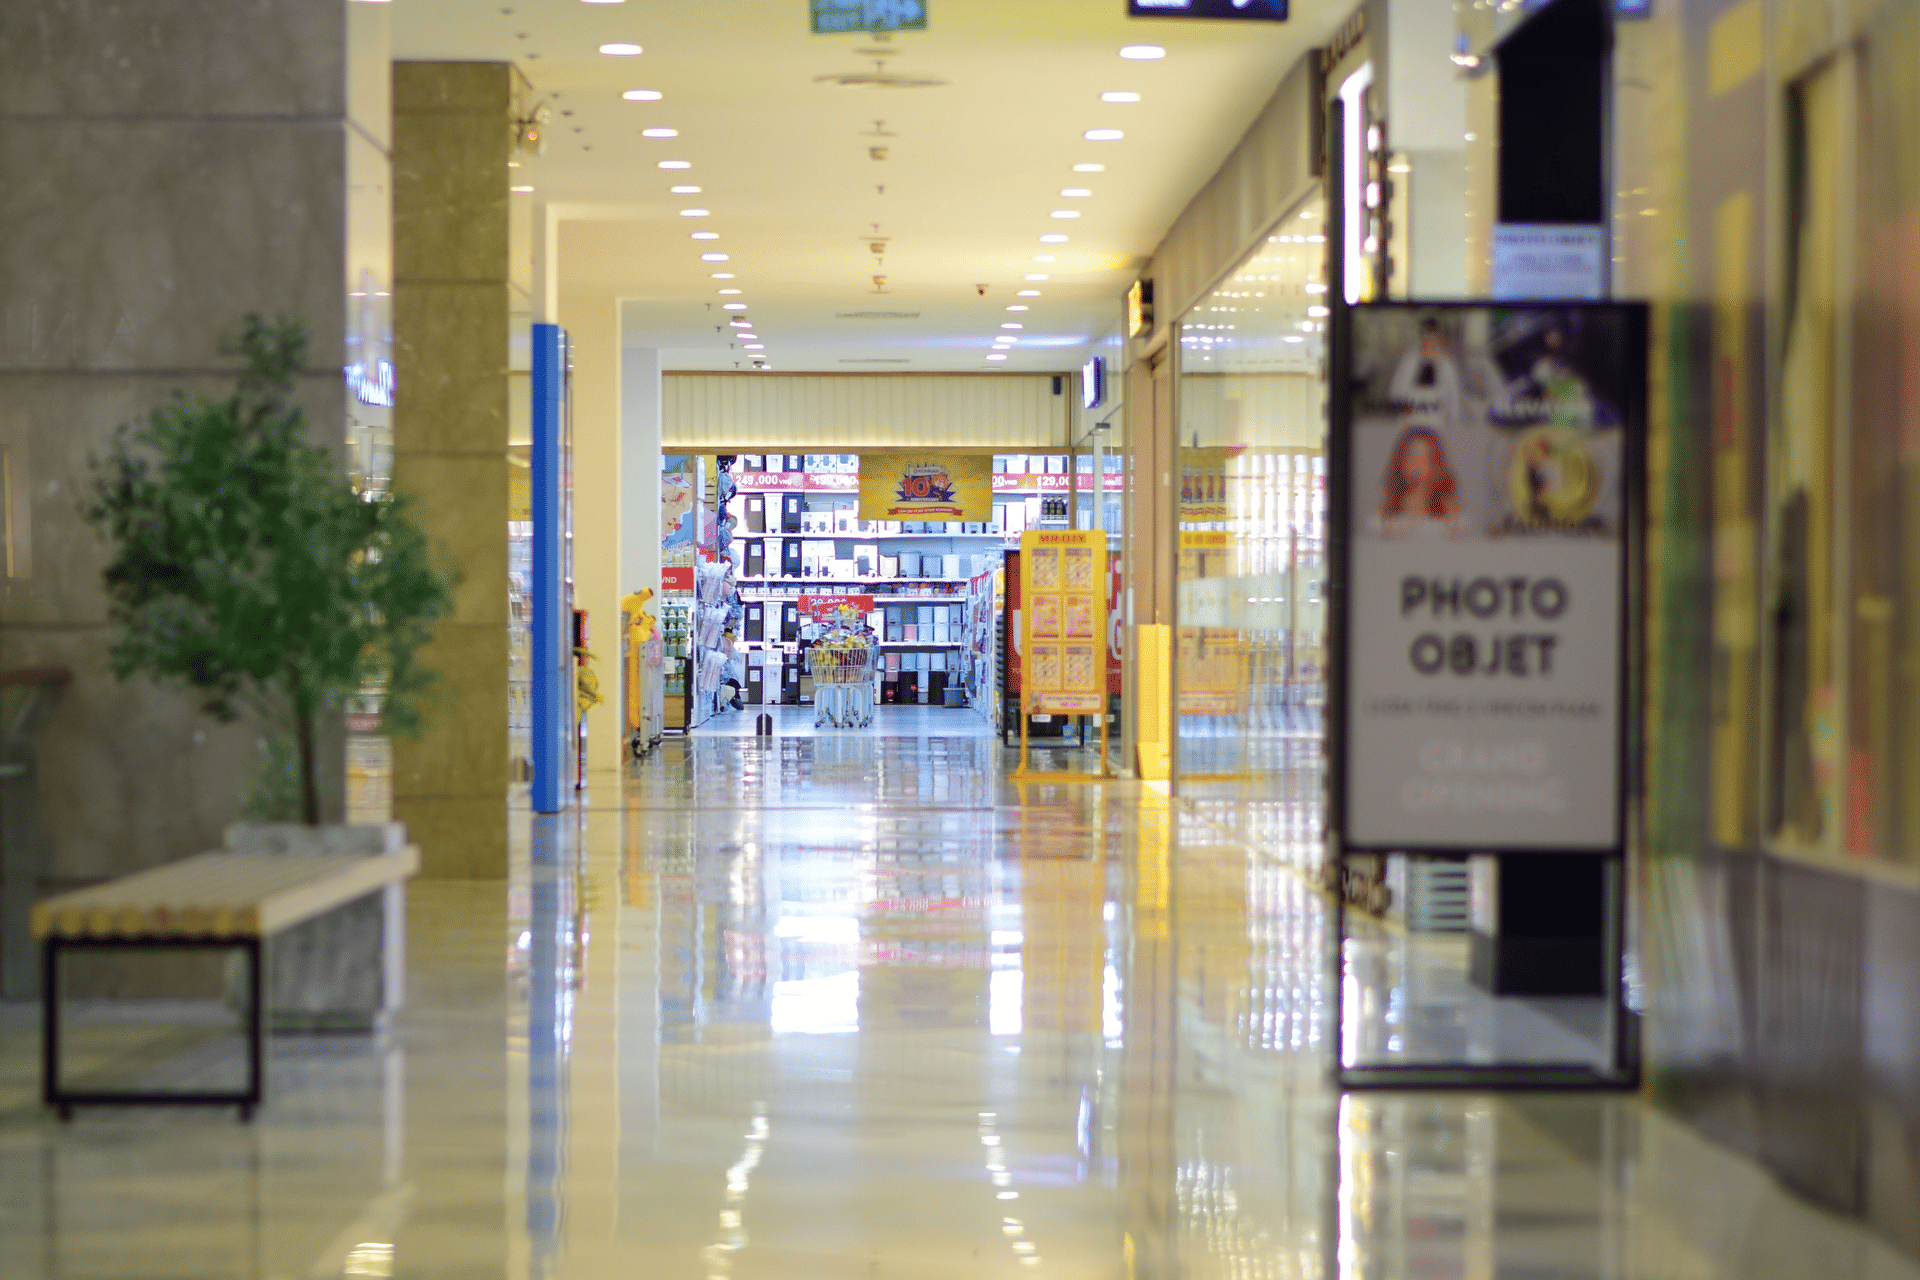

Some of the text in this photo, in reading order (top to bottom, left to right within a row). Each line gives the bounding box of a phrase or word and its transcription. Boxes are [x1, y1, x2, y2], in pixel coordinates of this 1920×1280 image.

[735, 475, 778, 486] 249,000
[1401, 576, 1567, 621] PHOTO
[1409, 633, 1559, 676] OBJET
